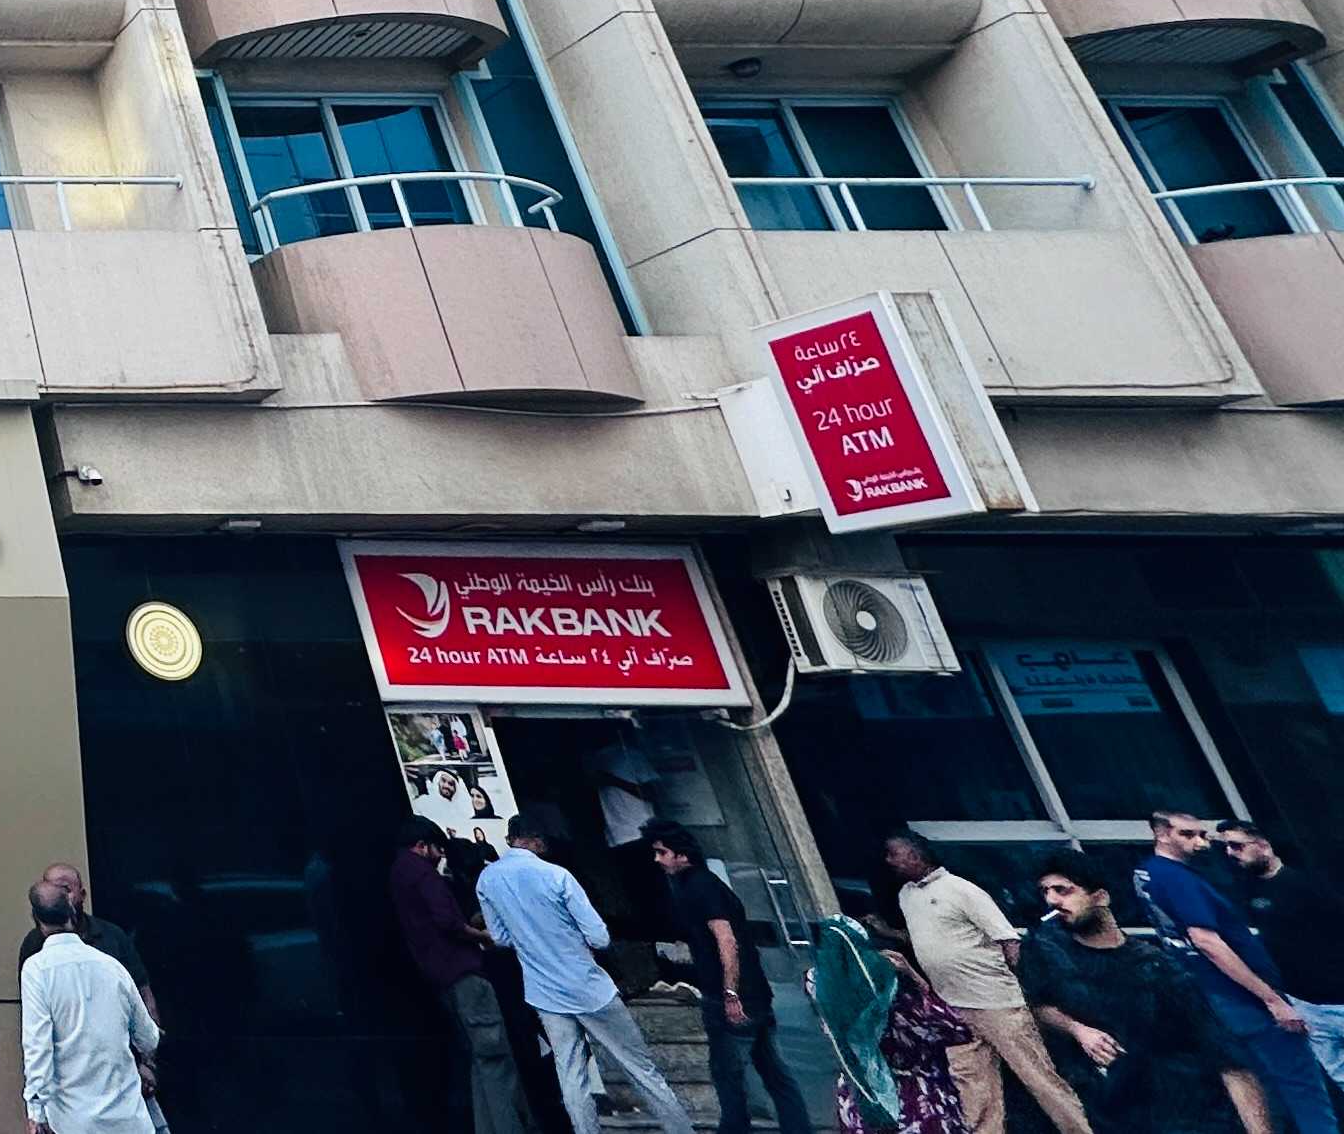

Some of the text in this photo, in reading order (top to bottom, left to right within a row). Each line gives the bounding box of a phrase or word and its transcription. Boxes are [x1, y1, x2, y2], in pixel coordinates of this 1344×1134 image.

[794, 342, 840, 362] ساعة
[812, 398, 893, 431] 24 hour
[842, 426, 895, 456] ATM
[864, 476, 928, 498] RAKBANK
[453, 570, 655, 599] بنك رأس الخيمة الوطني
[462, 606, 672, 638] RAKBANK
[407, 647, 529, 665] 24 hour ATM
[535, 646, 587, 665] ساعة
